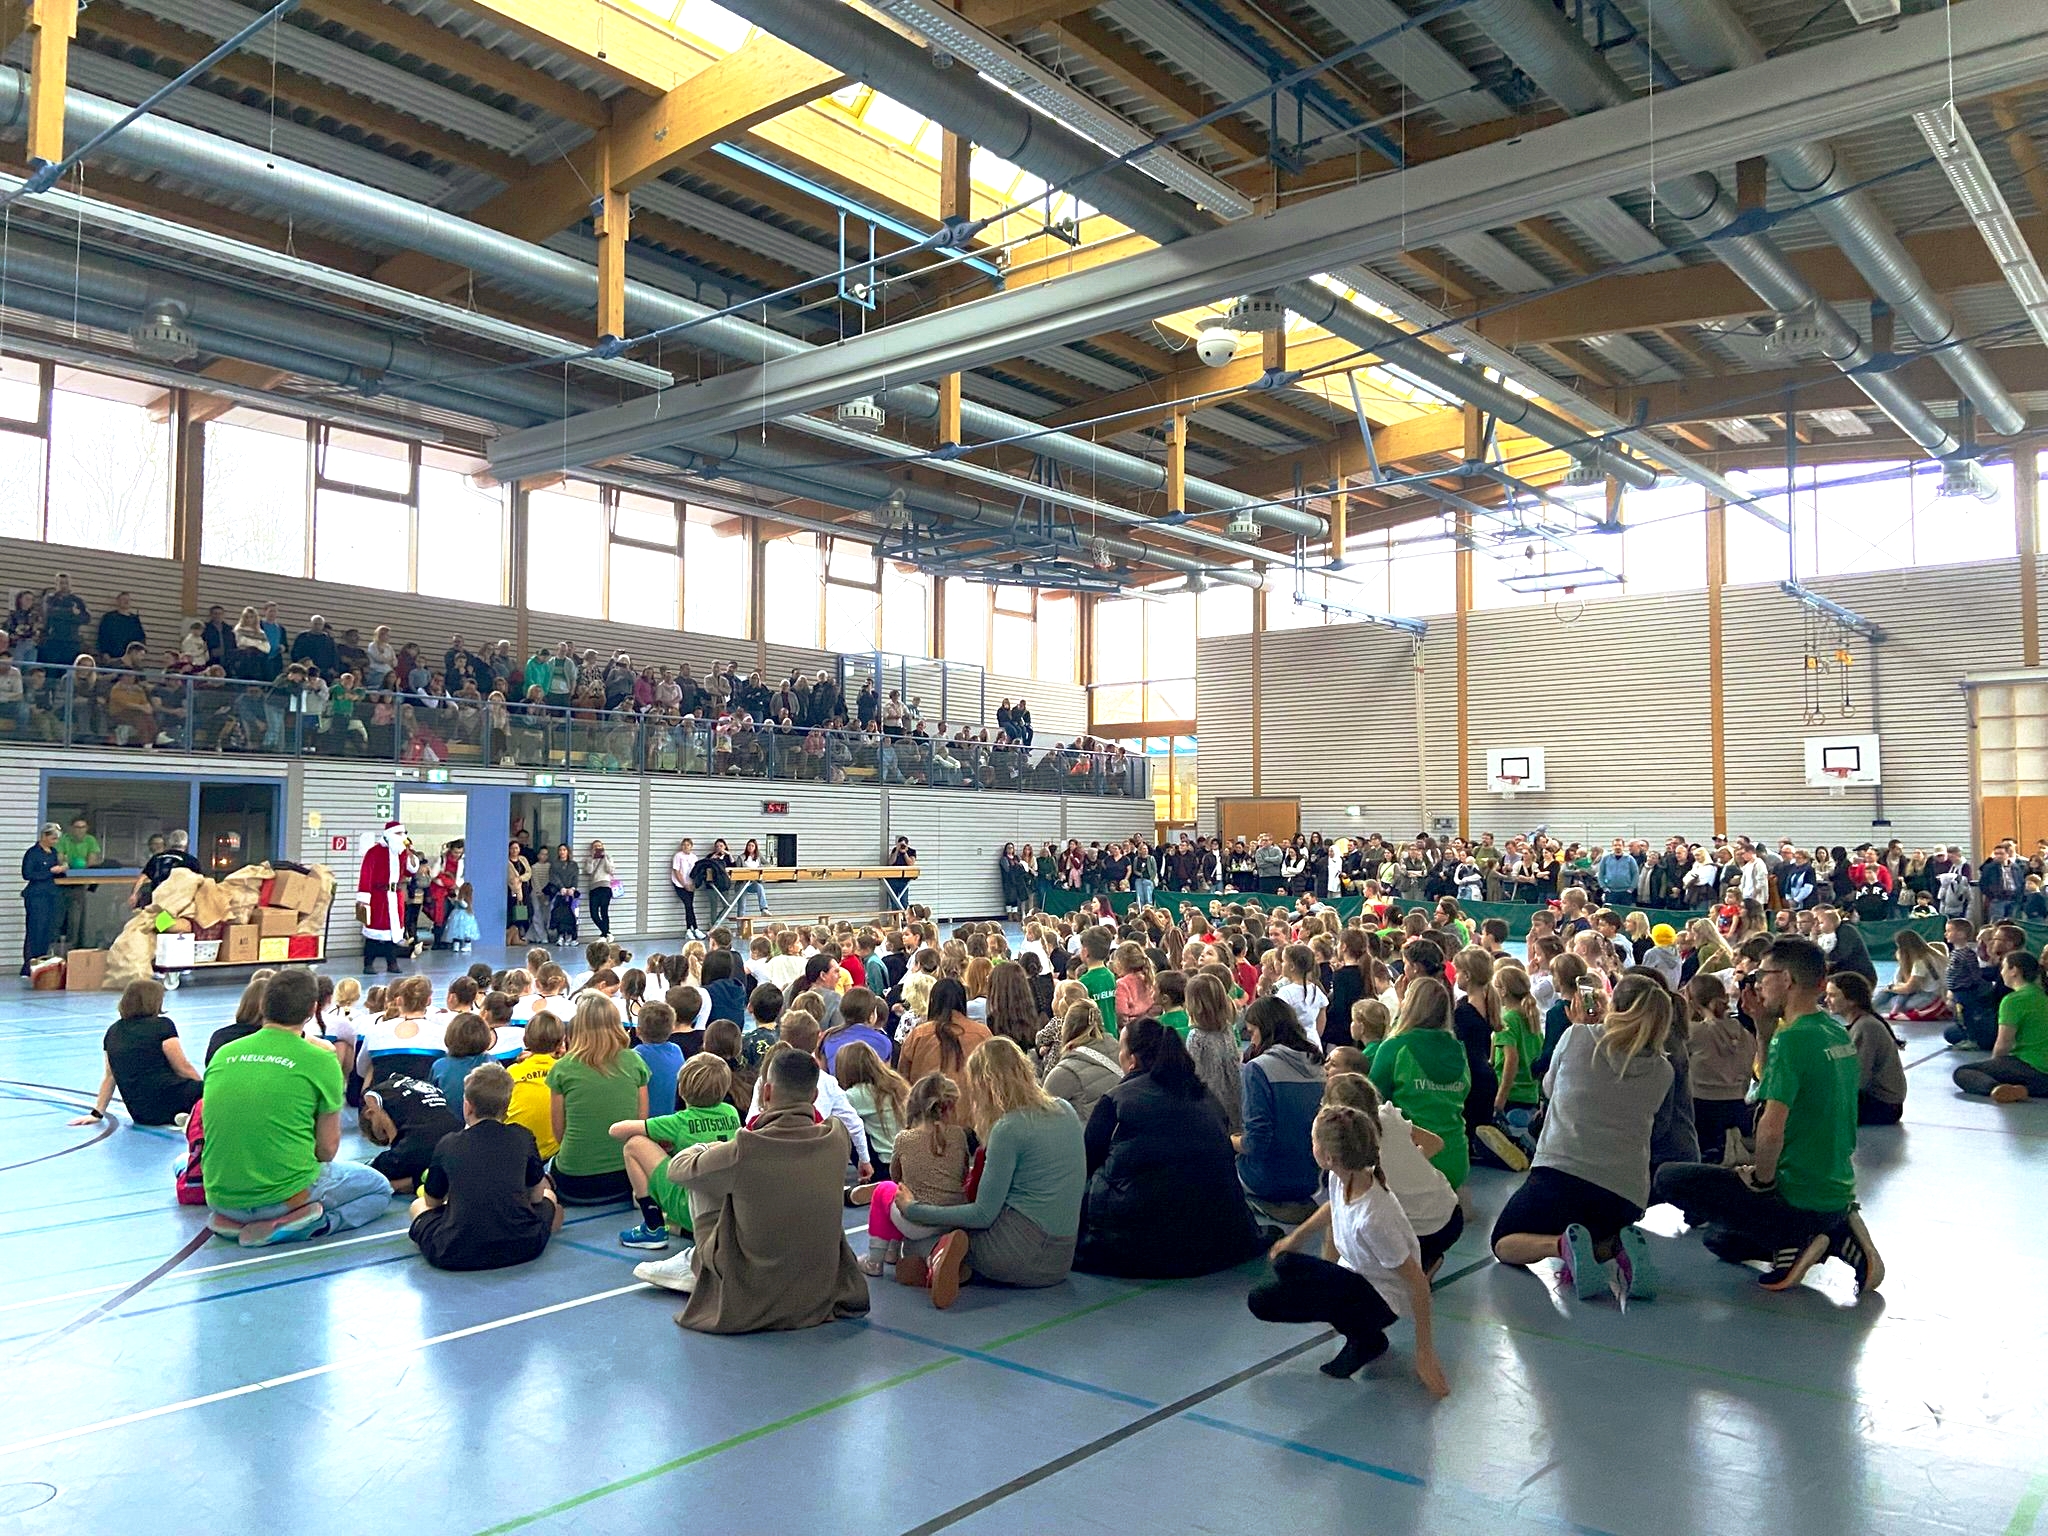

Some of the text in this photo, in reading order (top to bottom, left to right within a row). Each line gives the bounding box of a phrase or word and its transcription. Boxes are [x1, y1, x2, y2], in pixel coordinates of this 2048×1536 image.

[226, 1054, 296, 1069] TV NEULINGEN
[1413, 1078, 1426, 1090] TV
